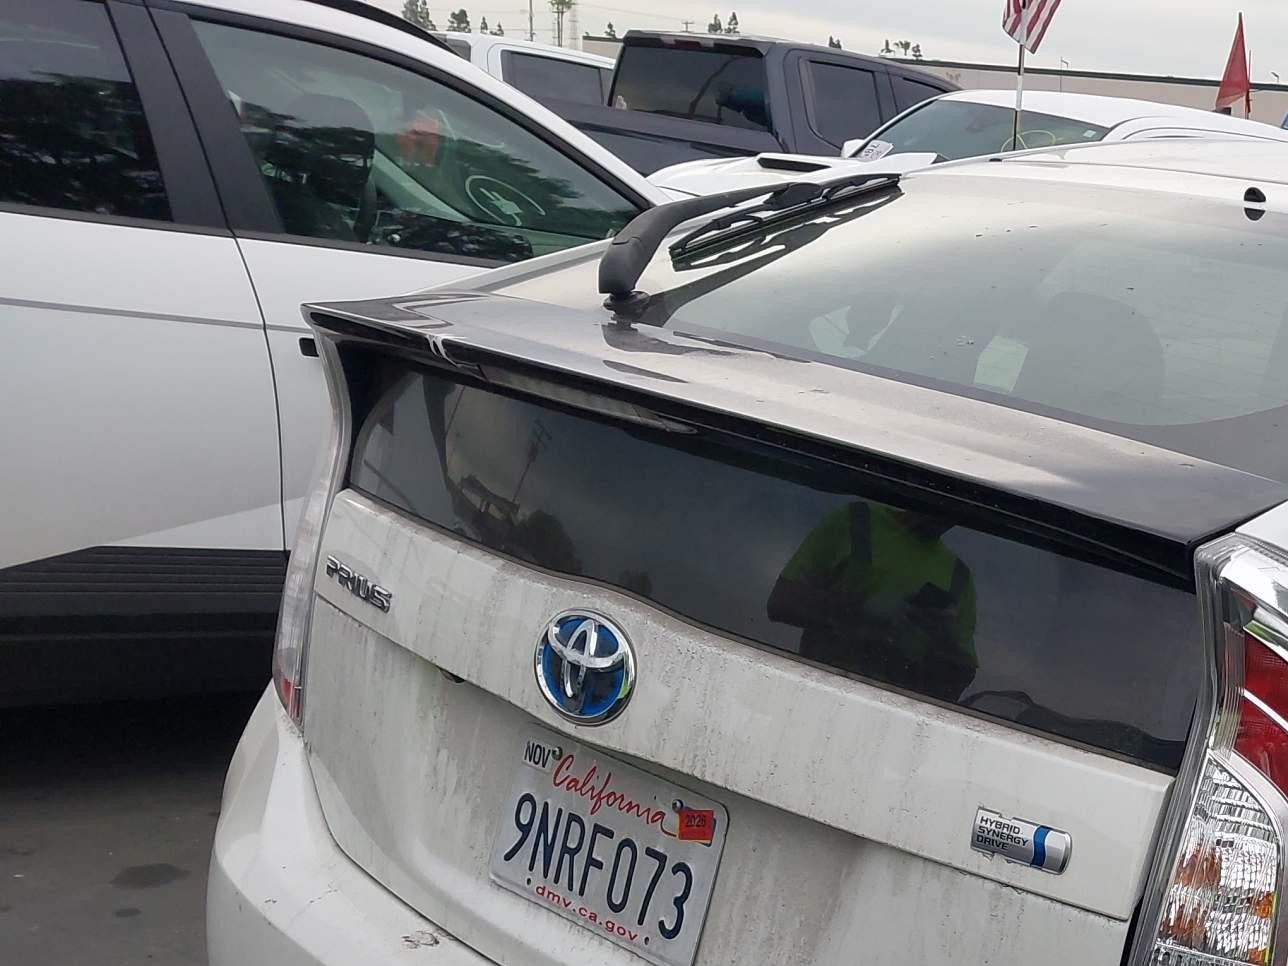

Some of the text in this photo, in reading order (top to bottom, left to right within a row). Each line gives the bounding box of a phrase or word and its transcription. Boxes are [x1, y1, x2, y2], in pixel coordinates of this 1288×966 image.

[326, 554, 393, 614] PRIUS
[523, 740, 551, 769] NOV
[552, 753, 677, 838] California
[976, 834, 1009, 850] DRIVE
[977, 825, 1029, 847] SYNERGY
[980, 815, 1020, 835] HYBRID
[503, 792, 693, 940] 9NRF073
[535, 884, 638, 942] dmv.ca.gov
